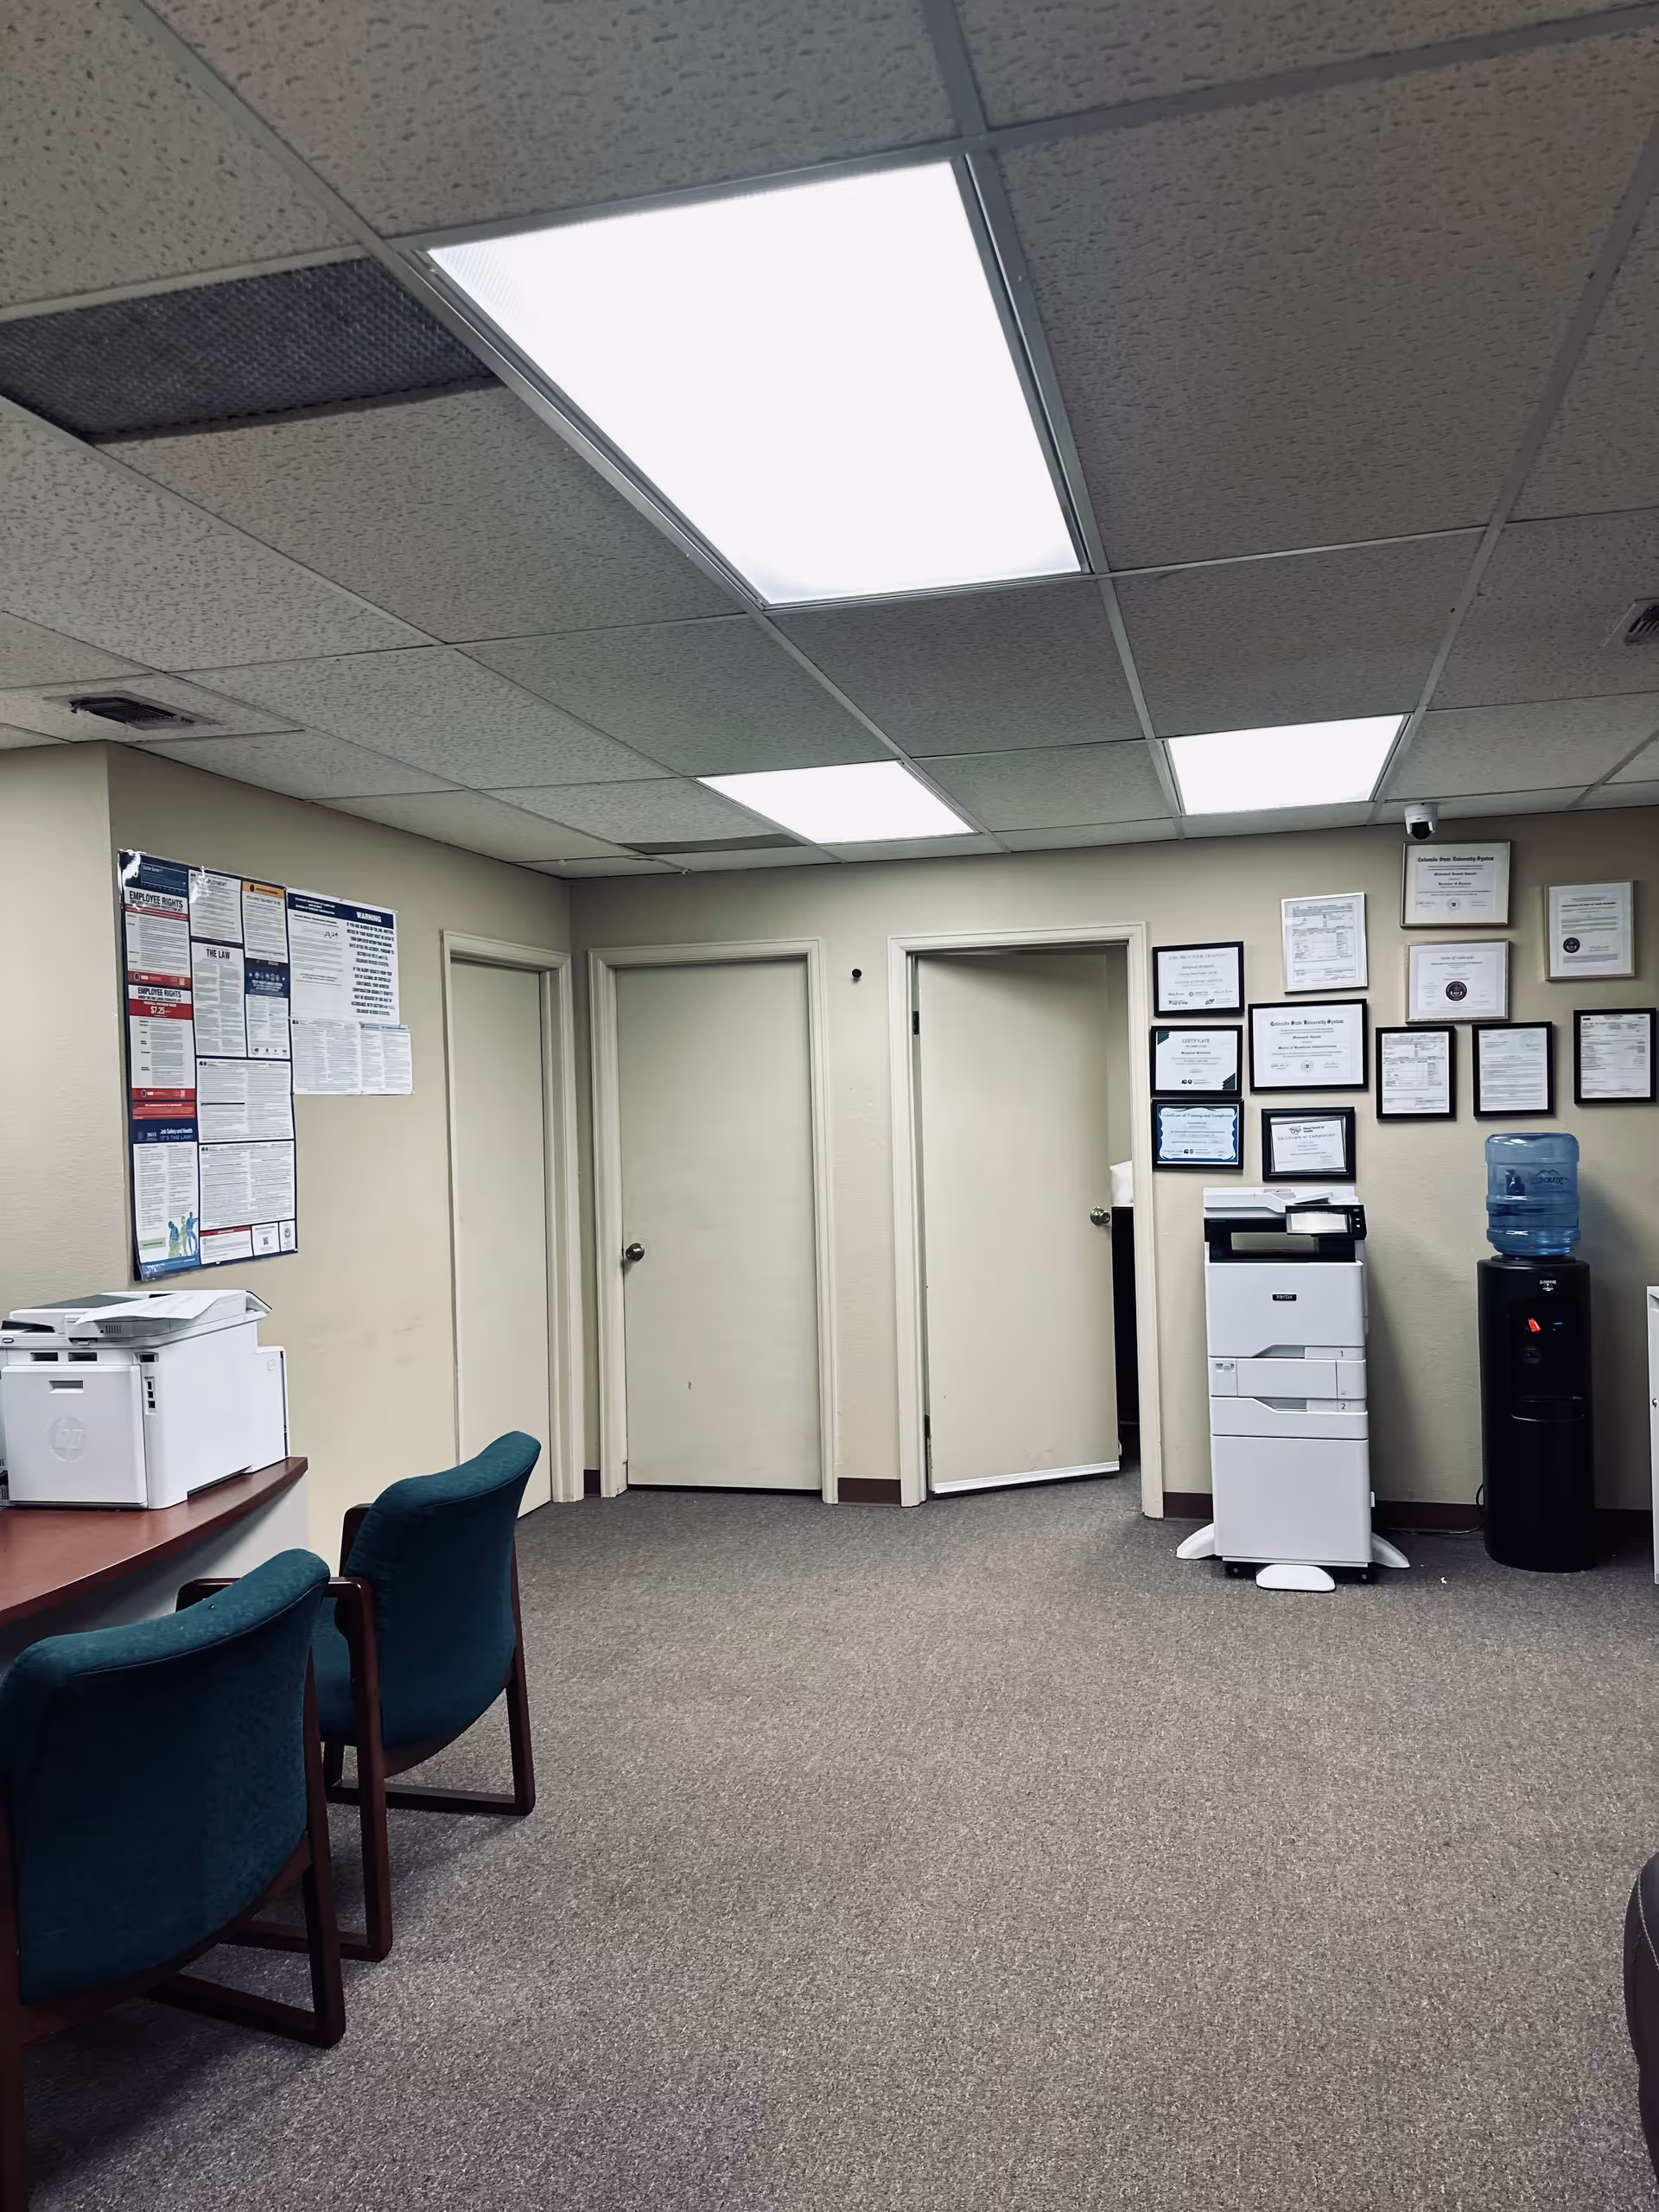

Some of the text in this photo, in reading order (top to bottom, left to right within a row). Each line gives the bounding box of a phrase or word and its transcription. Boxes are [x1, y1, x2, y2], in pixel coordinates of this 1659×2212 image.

[130, 891, 183, 908] EMPLOYEE RIGHTS
[356, 912, 382, 923] WARNING
[207, 949, 230, 959] THE LAW
[138, 987, 162, 996] EMPLOYEE
[150, 1006, 165, 1014] $7.25
